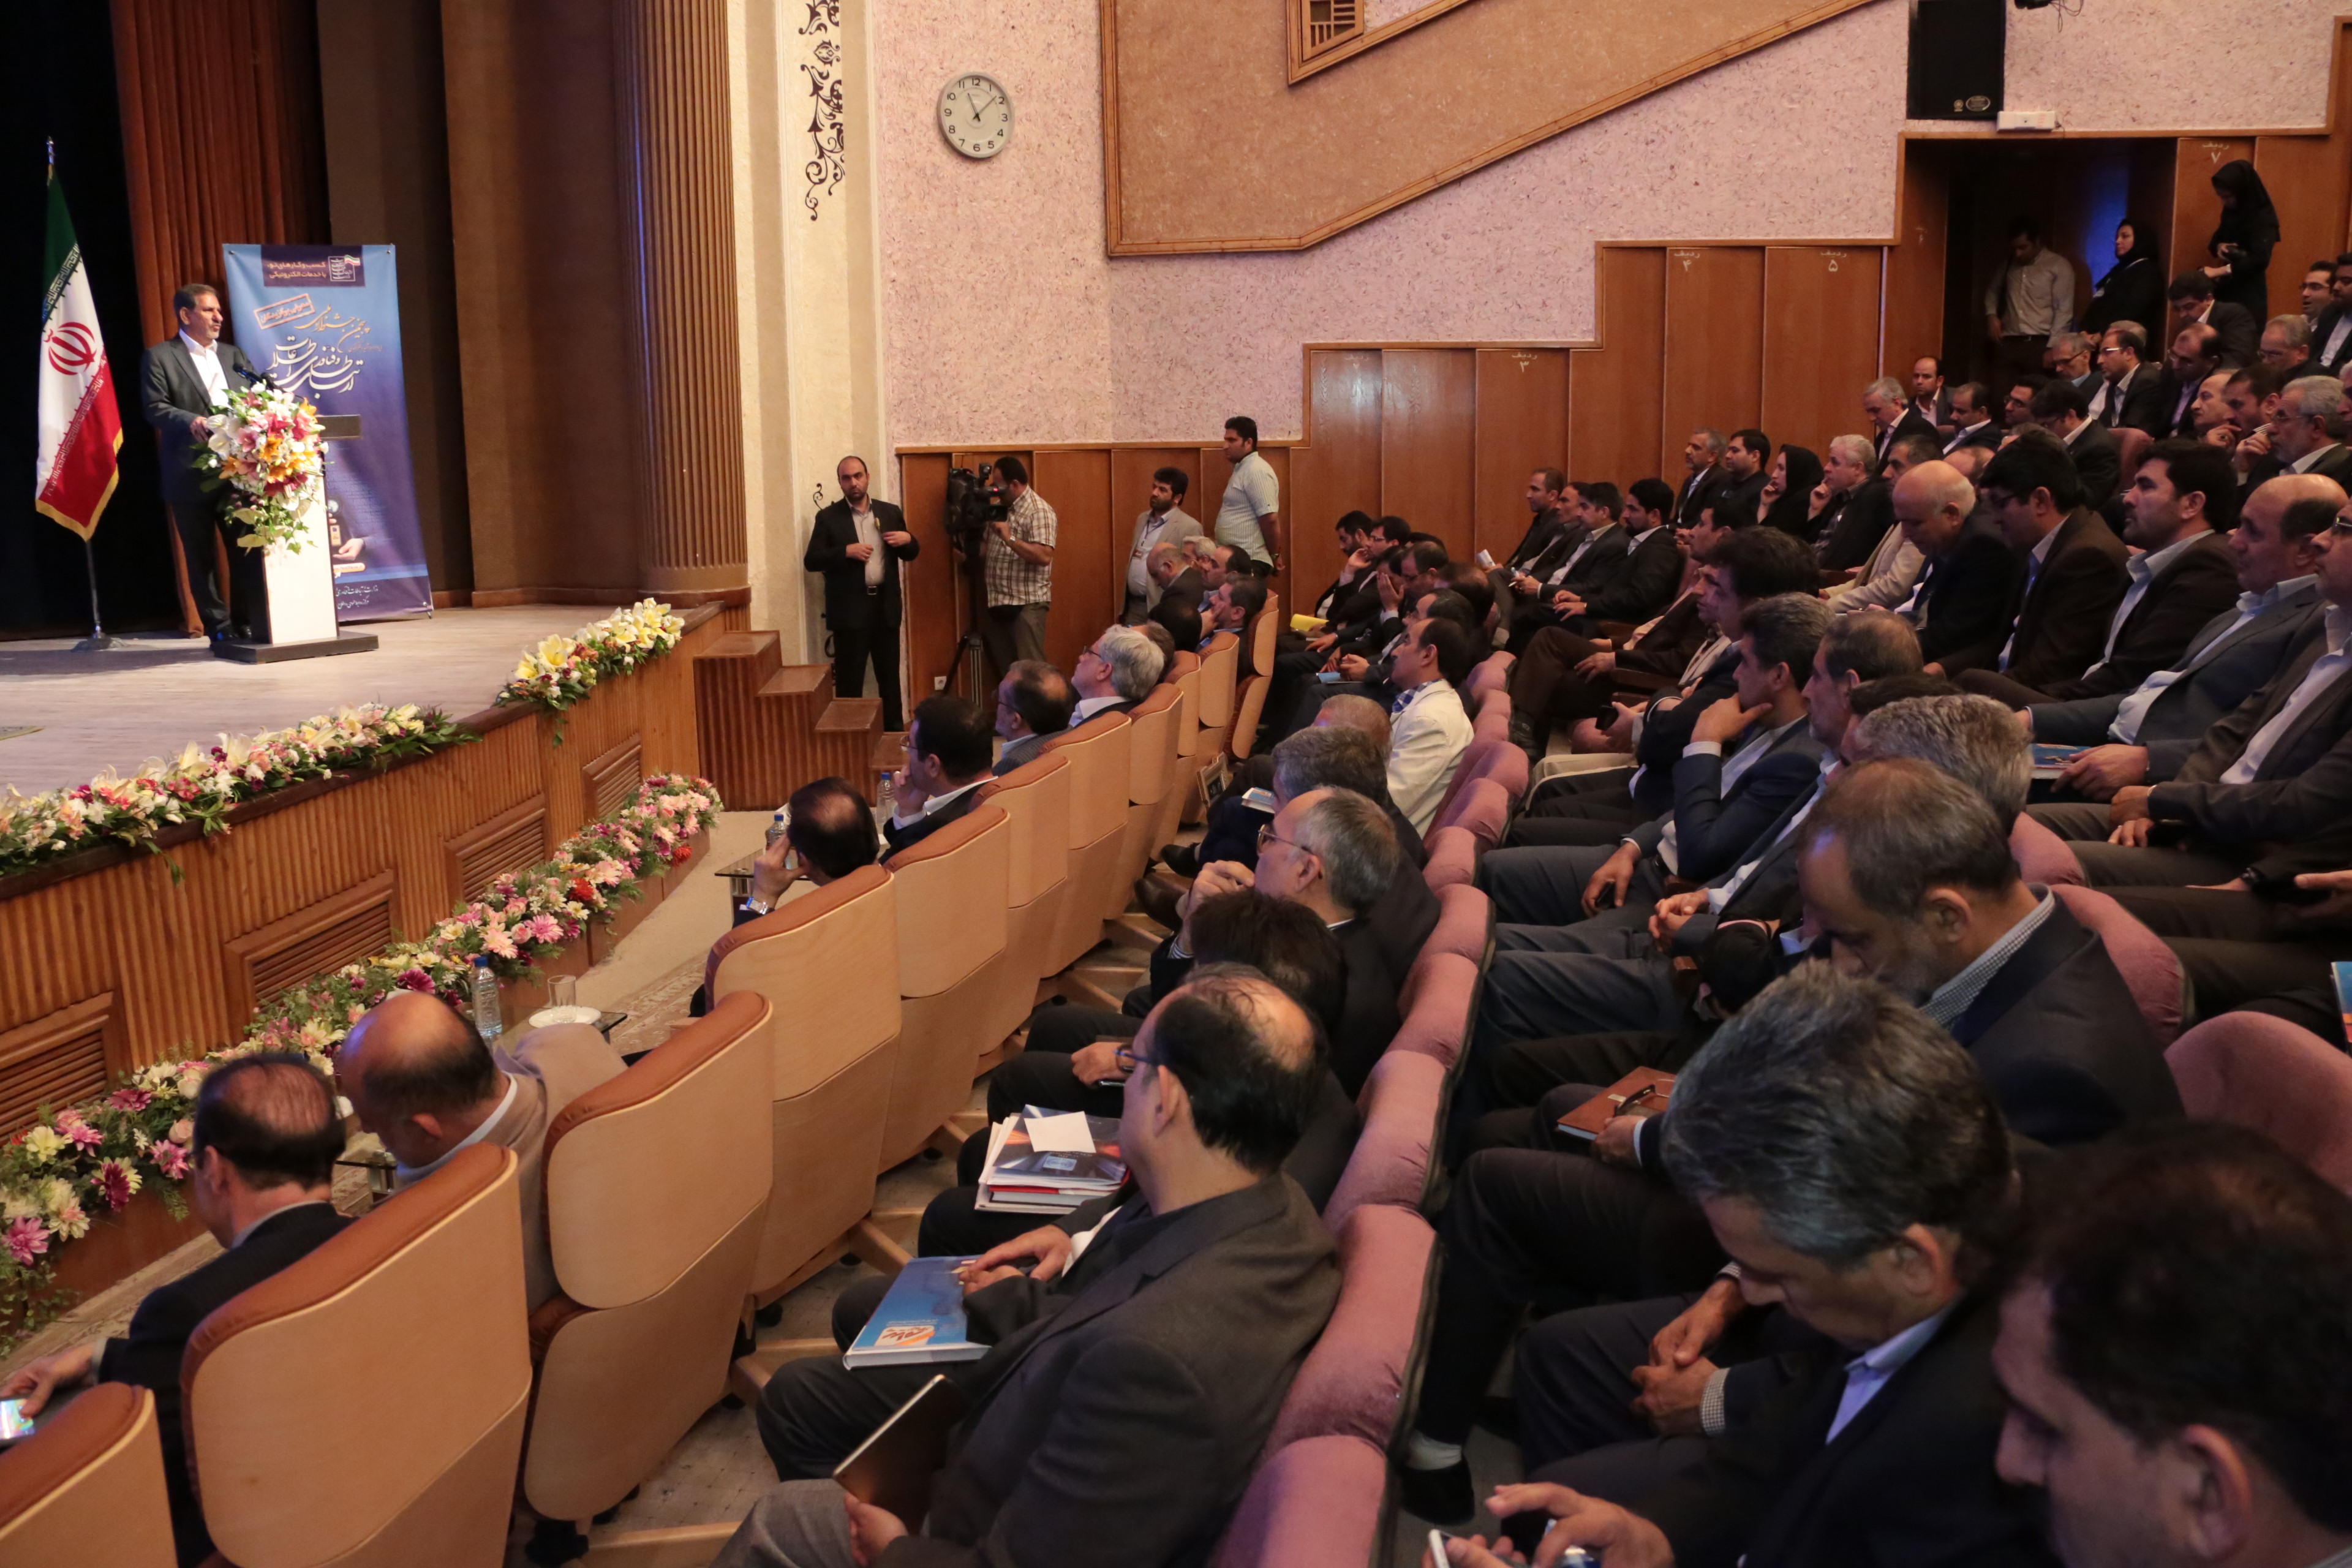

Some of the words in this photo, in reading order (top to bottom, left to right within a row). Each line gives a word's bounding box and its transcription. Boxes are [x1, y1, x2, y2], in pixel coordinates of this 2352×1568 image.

[944, 108, 952, 117] 9
[1001, 113, 1008, 122] 3
[948, 125, 956, 134] 8
[997, 129, 1004, 137] 4
[959, 138, 965, 147] 7
[2202, 141, 2230, 150] ردیف
[2211, 151, 2222, 164] ۷
[1673, 250, 1701, 258] ردیف
[1820, 249, 1847, 258] ردیف
[1683, 259, 1692, 271] ۴
[1828, 259, 1838, 272] ۵
[1520, 361, 1529, 372] ۳
